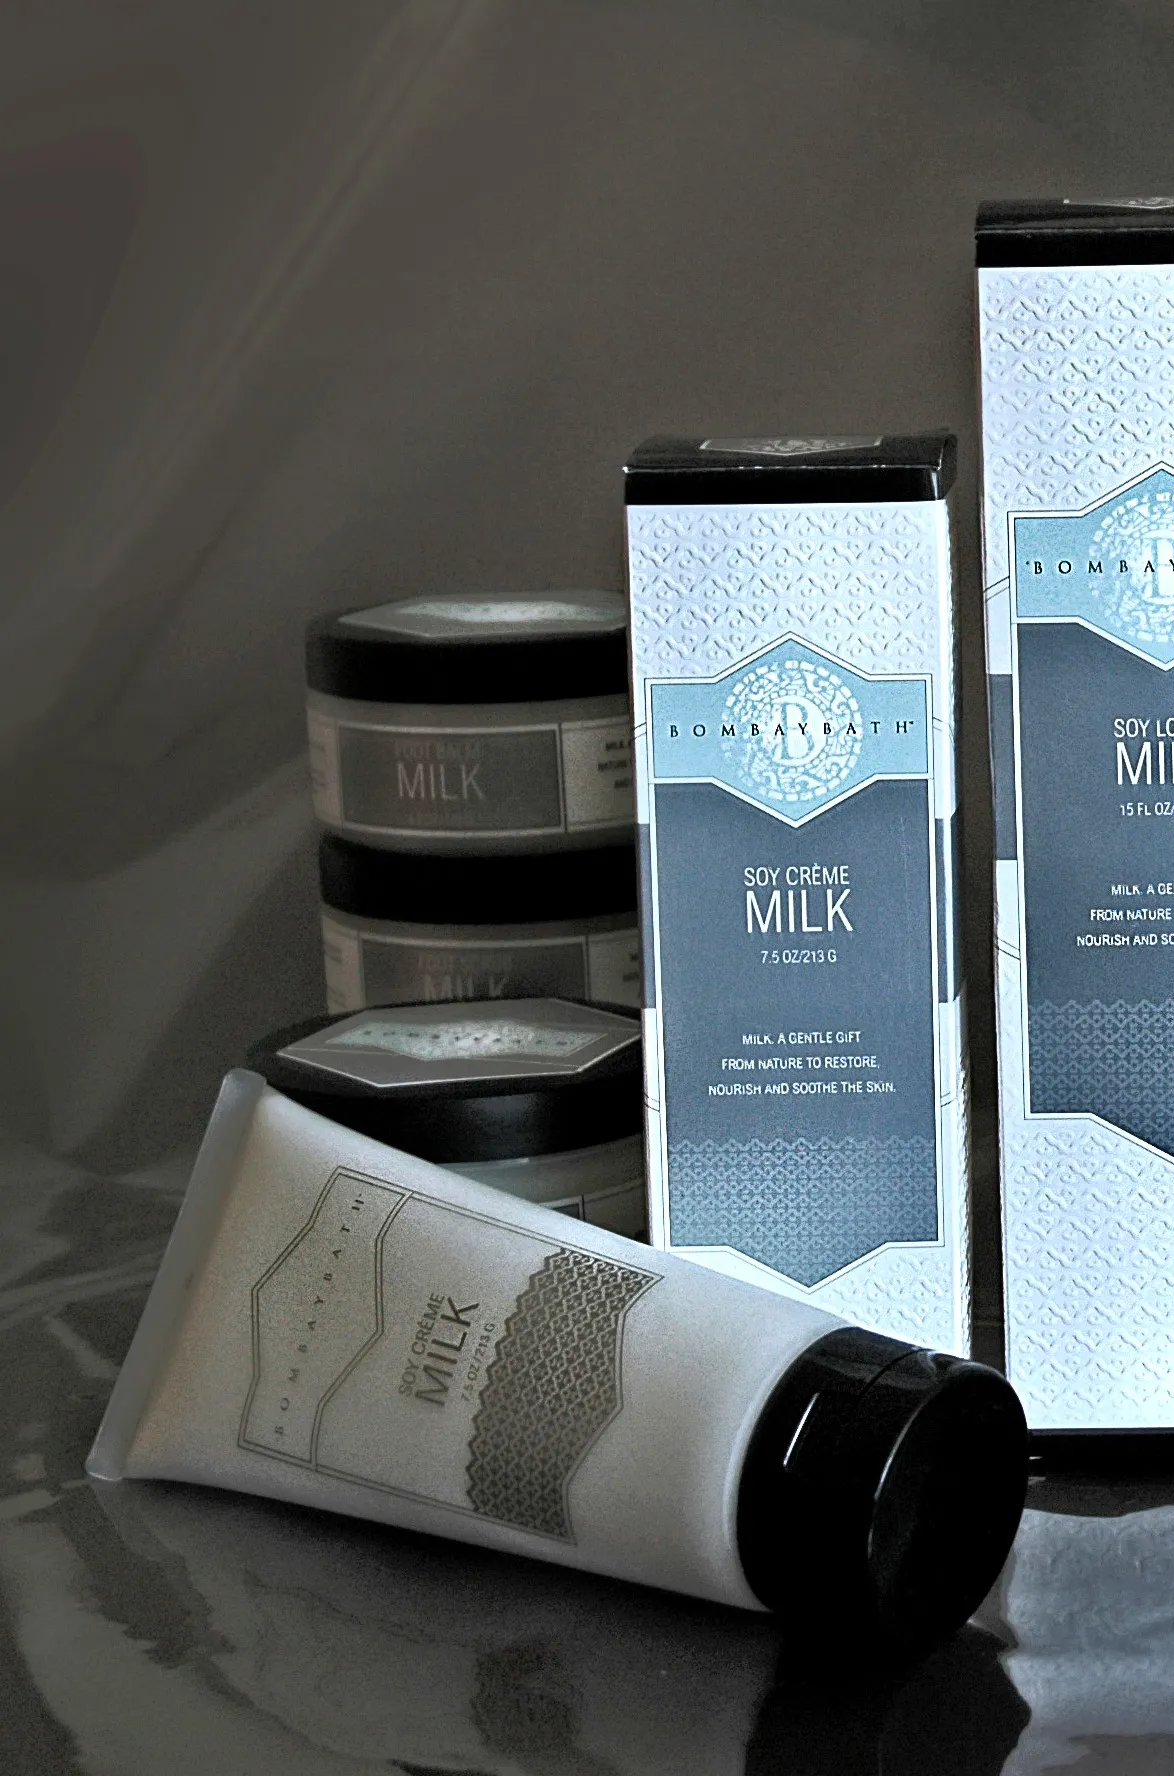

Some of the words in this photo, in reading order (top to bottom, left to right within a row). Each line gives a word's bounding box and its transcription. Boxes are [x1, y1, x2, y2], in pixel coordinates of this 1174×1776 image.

[1114, 718, 1150, 737] SOY
[397, 761, 484, 800] MILK
[1120, 803, 1133, 816] 15
[1137, 803, 1151, 816] FL
[744, 867, 780, 886] SOY
[786, 862, 850, 886] CRÈME
[1146, 884, 1155, 895] A
[746, 888, 853, 933] MILK
[1090, 909, 1123, 921] FROM
[1126, 908, 1172, 921] NATURE
[1076, 934, 1130, 947] NOURISH
[1133, 933, 1158, 946] AND
[761, 950, 780, 964] 7.5
[827, 949, 837, 962] G
[777, 1032, 786, 1044] A
[789, 1031, 833, 1044] GENTLE
[836, 1031, 861, 1043] GIFT
[721, 1058, 755, 1070] FROM
[758, 1057, 803, 1070] NATURE
[806, 1057, 822, 1069] TO
[708, 1082, 762, 1096] NOURISH
[765, 1082, 789, 1095] AND
[792, 1081, 838, 1094] SOOTHE
[841, 1080, 863, 1093] THE
[483, 1323, 496, 1333] G
[415, 1296, 480, 1407] MILK
[398, 1358, 420, 1398] SOY
